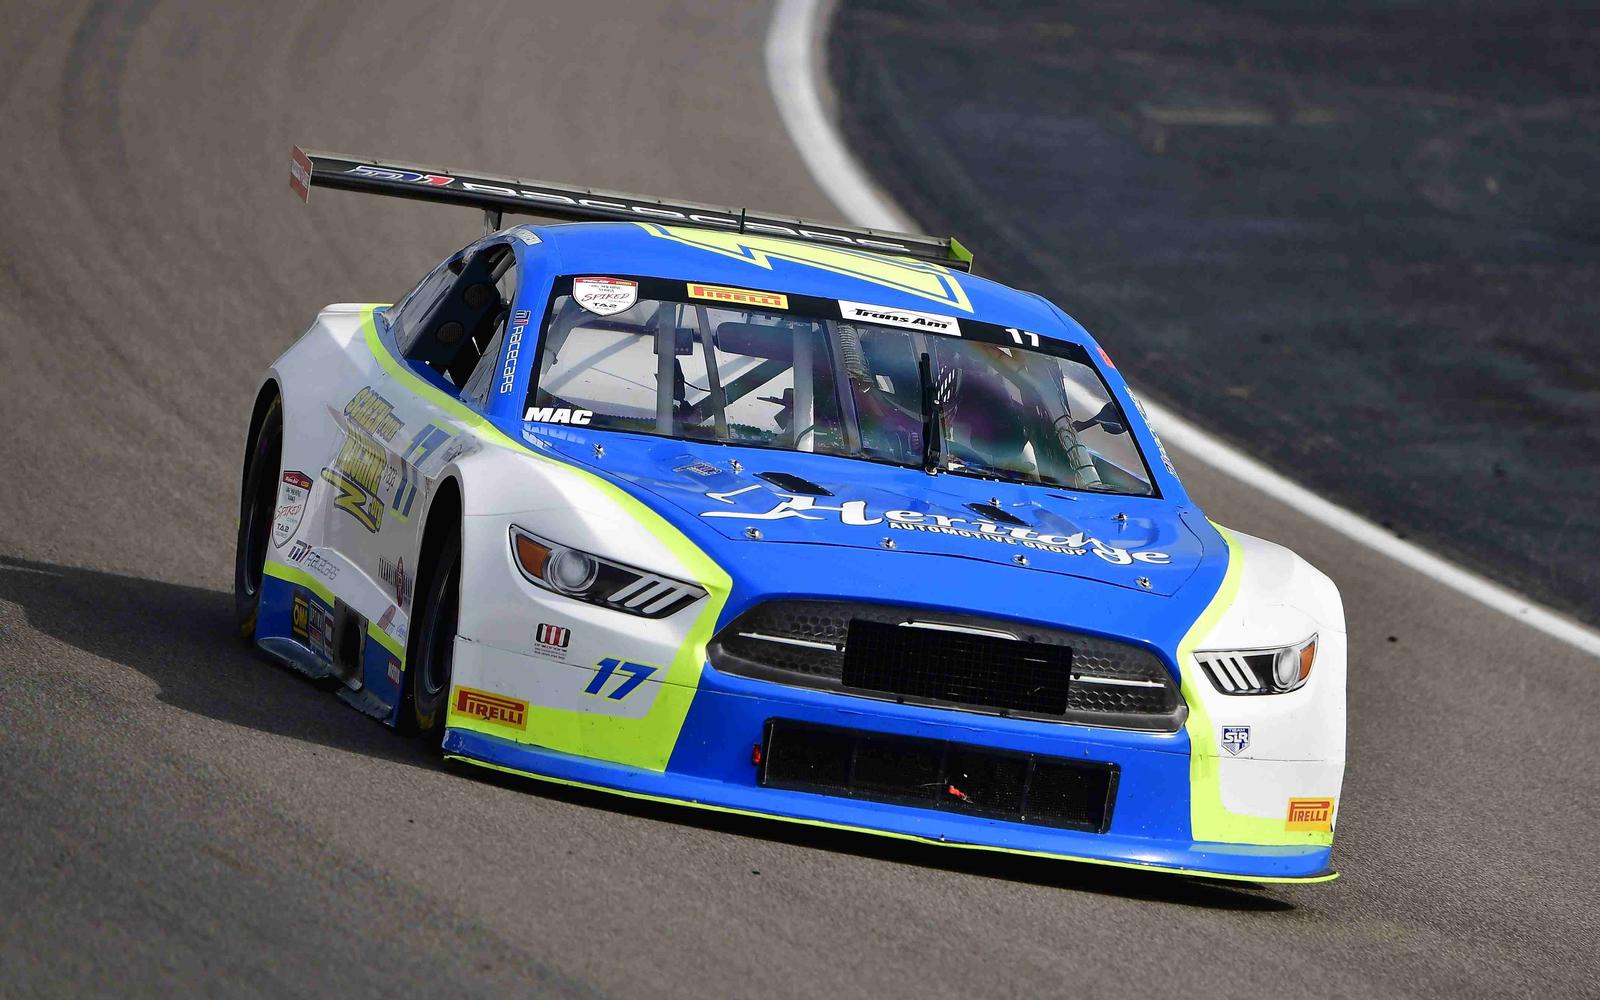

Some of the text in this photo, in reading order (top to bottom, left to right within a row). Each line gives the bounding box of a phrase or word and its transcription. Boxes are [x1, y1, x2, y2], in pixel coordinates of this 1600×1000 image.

[693, 286, 781, 306] PIRELLI
[855, 308, 949, 329] Trans Am
[1005, 328, 1040, 347] 17
[524, 407, 593, 425] MAC
[277, 523, 290, 532] TA2
[698, 484, 1171, 565] Heritage
[888, 521, 1087, 556] AUTOMOTIVE GROUP
[584, 657, 659, 701] 17
[457, 690, 525, 725] PIRELLI
[1224, 731, 1249, 743] SLR
[1288, 800, 1331, 822] PIRELLI
